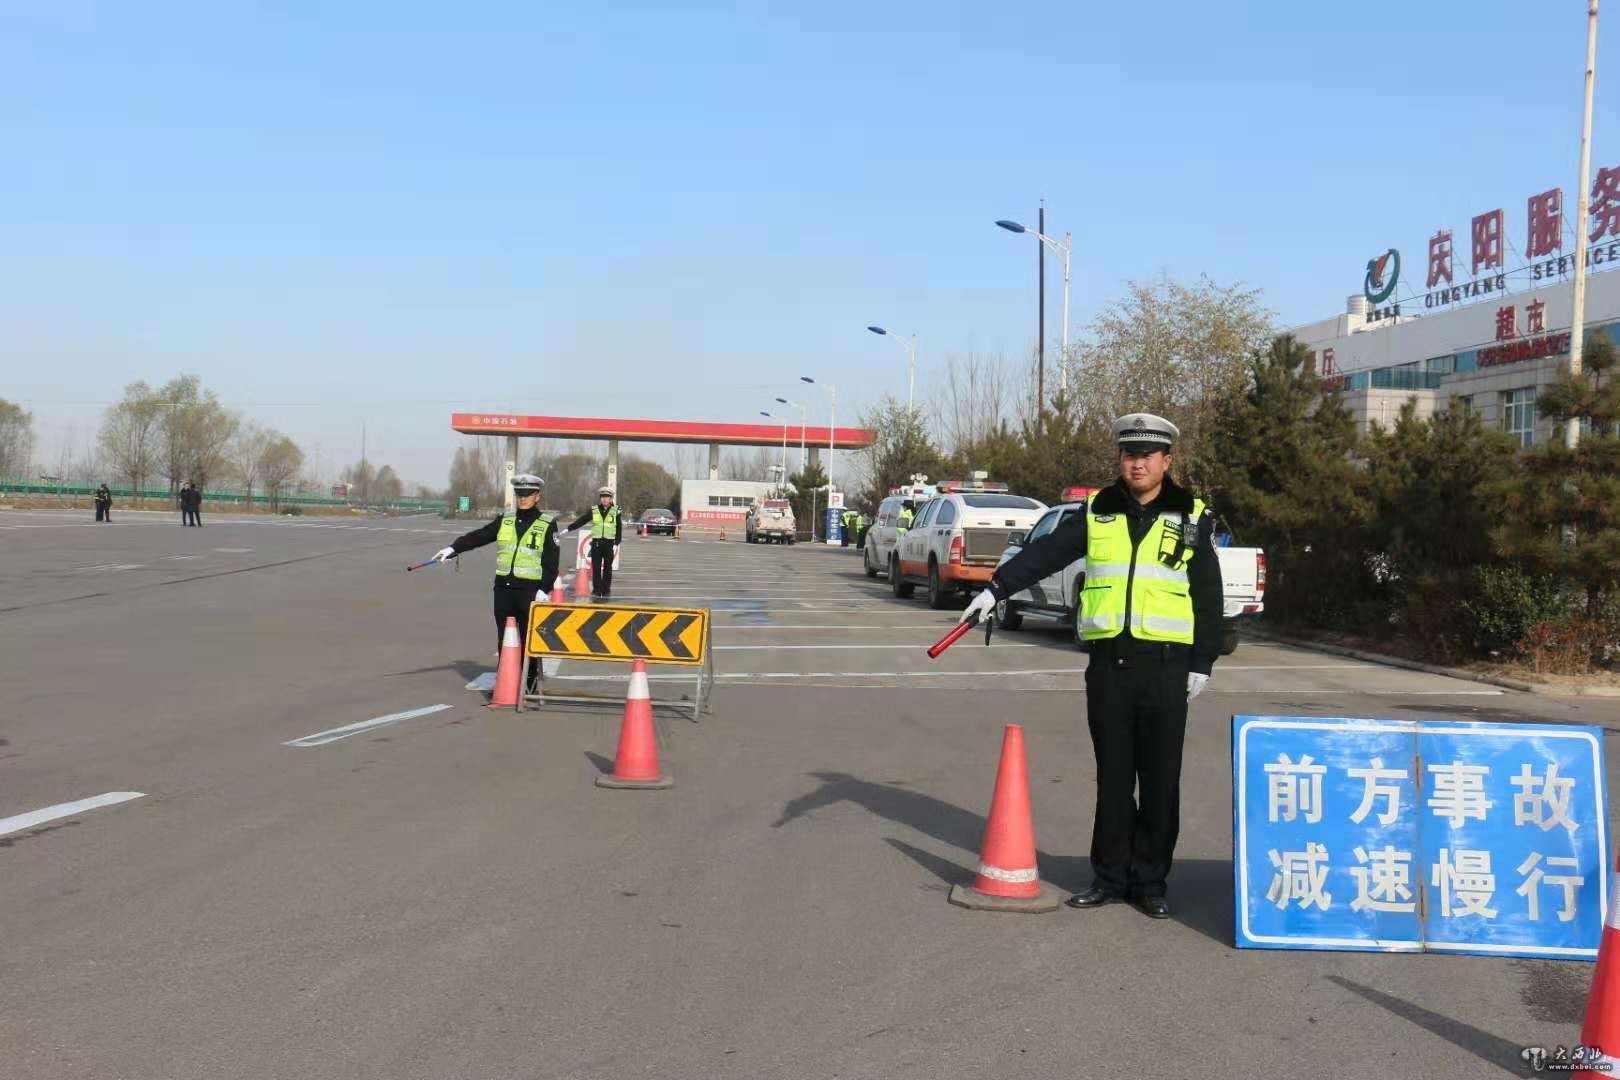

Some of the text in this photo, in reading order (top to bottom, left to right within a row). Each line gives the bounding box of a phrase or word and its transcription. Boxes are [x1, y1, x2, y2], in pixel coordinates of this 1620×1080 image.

[1425, 275, 1505, 308] QINGYANG
[1495, 299, 1546, 341] 超市
[1264, 753, 1580, 831] 前方事故
[1265, 842, 1585, 922] 减速慢行
